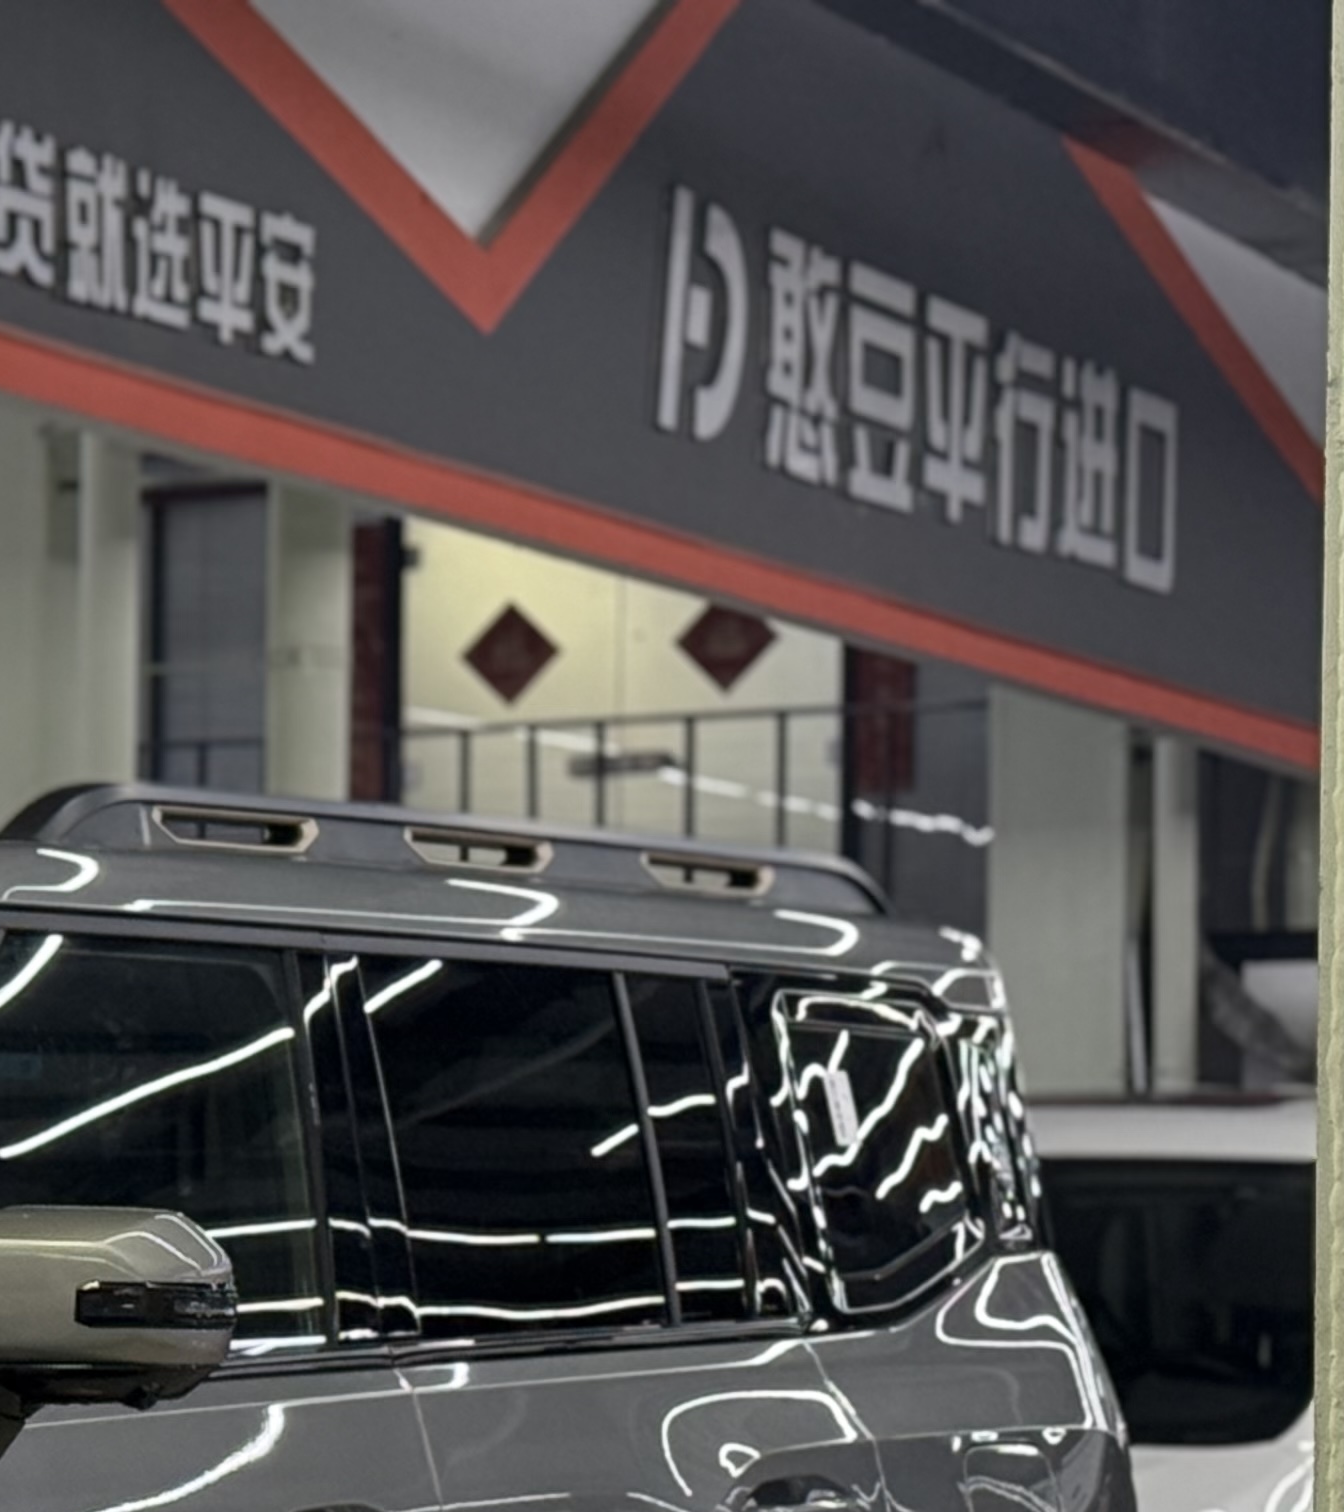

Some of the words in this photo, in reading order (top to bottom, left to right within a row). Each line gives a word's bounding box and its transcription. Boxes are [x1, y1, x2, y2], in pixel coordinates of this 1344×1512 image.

[764, 225, 1180, 596] 憨豆平行进口
